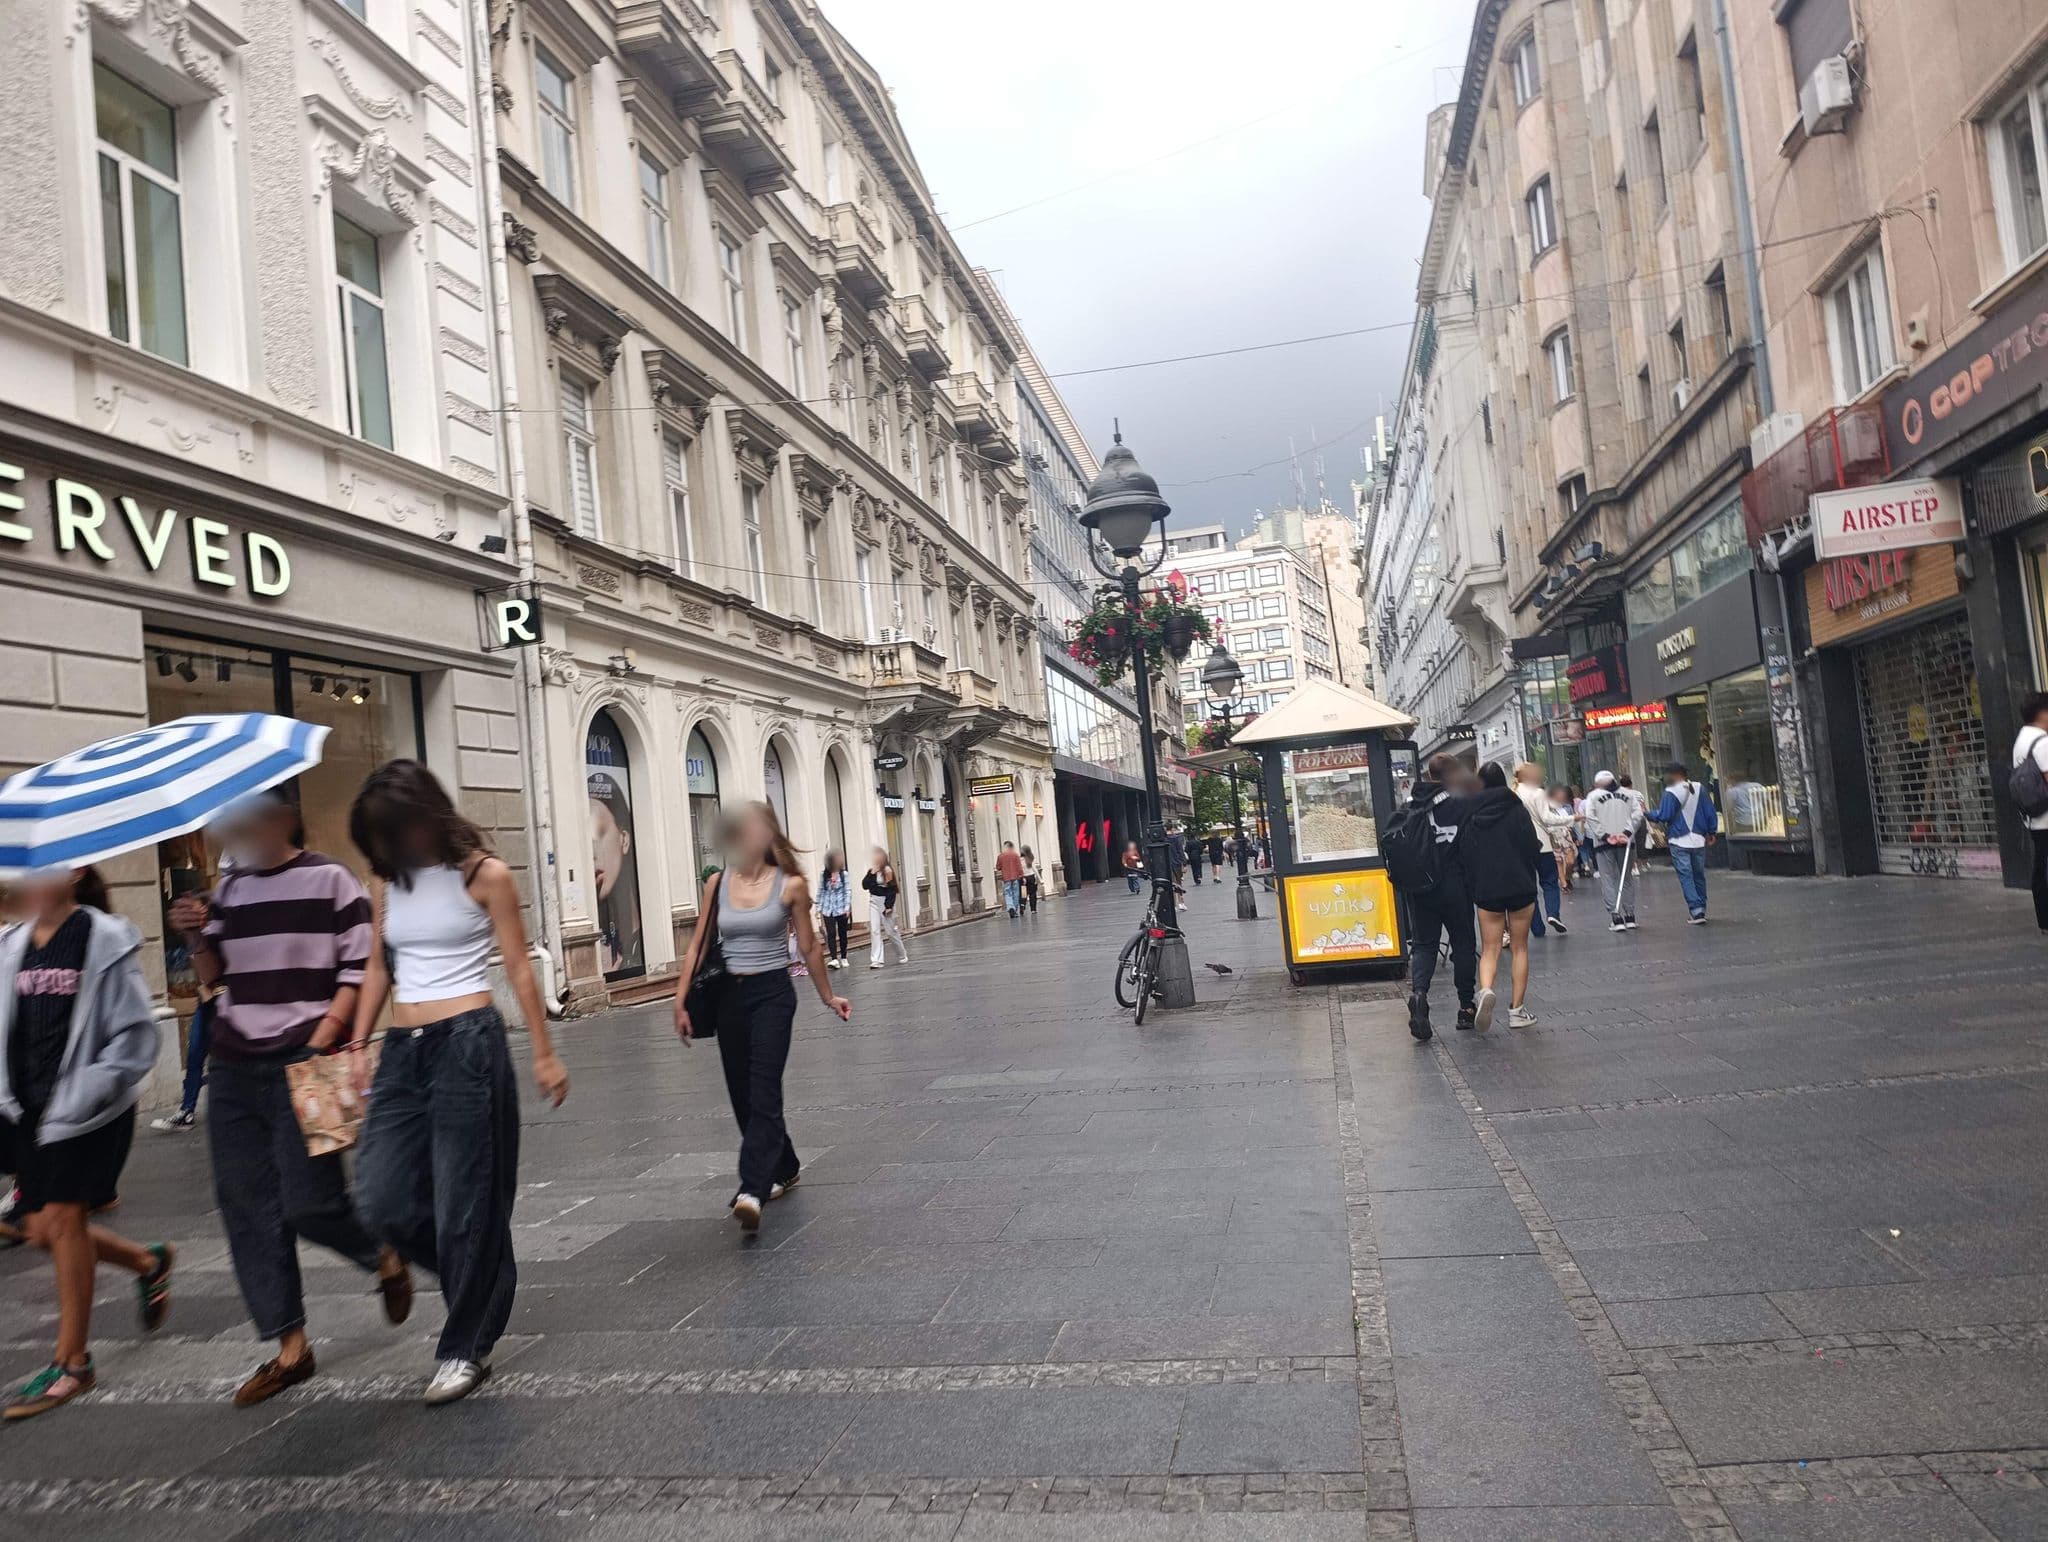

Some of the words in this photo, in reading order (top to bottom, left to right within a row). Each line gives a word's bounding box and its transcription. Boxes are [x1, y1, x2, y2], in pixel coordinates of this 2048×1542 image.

[1842, 497, 1939, 533] AIRSTEP
[497, 599, 536, 644] R
[1298, 752, 1363, 769] POPCORN
